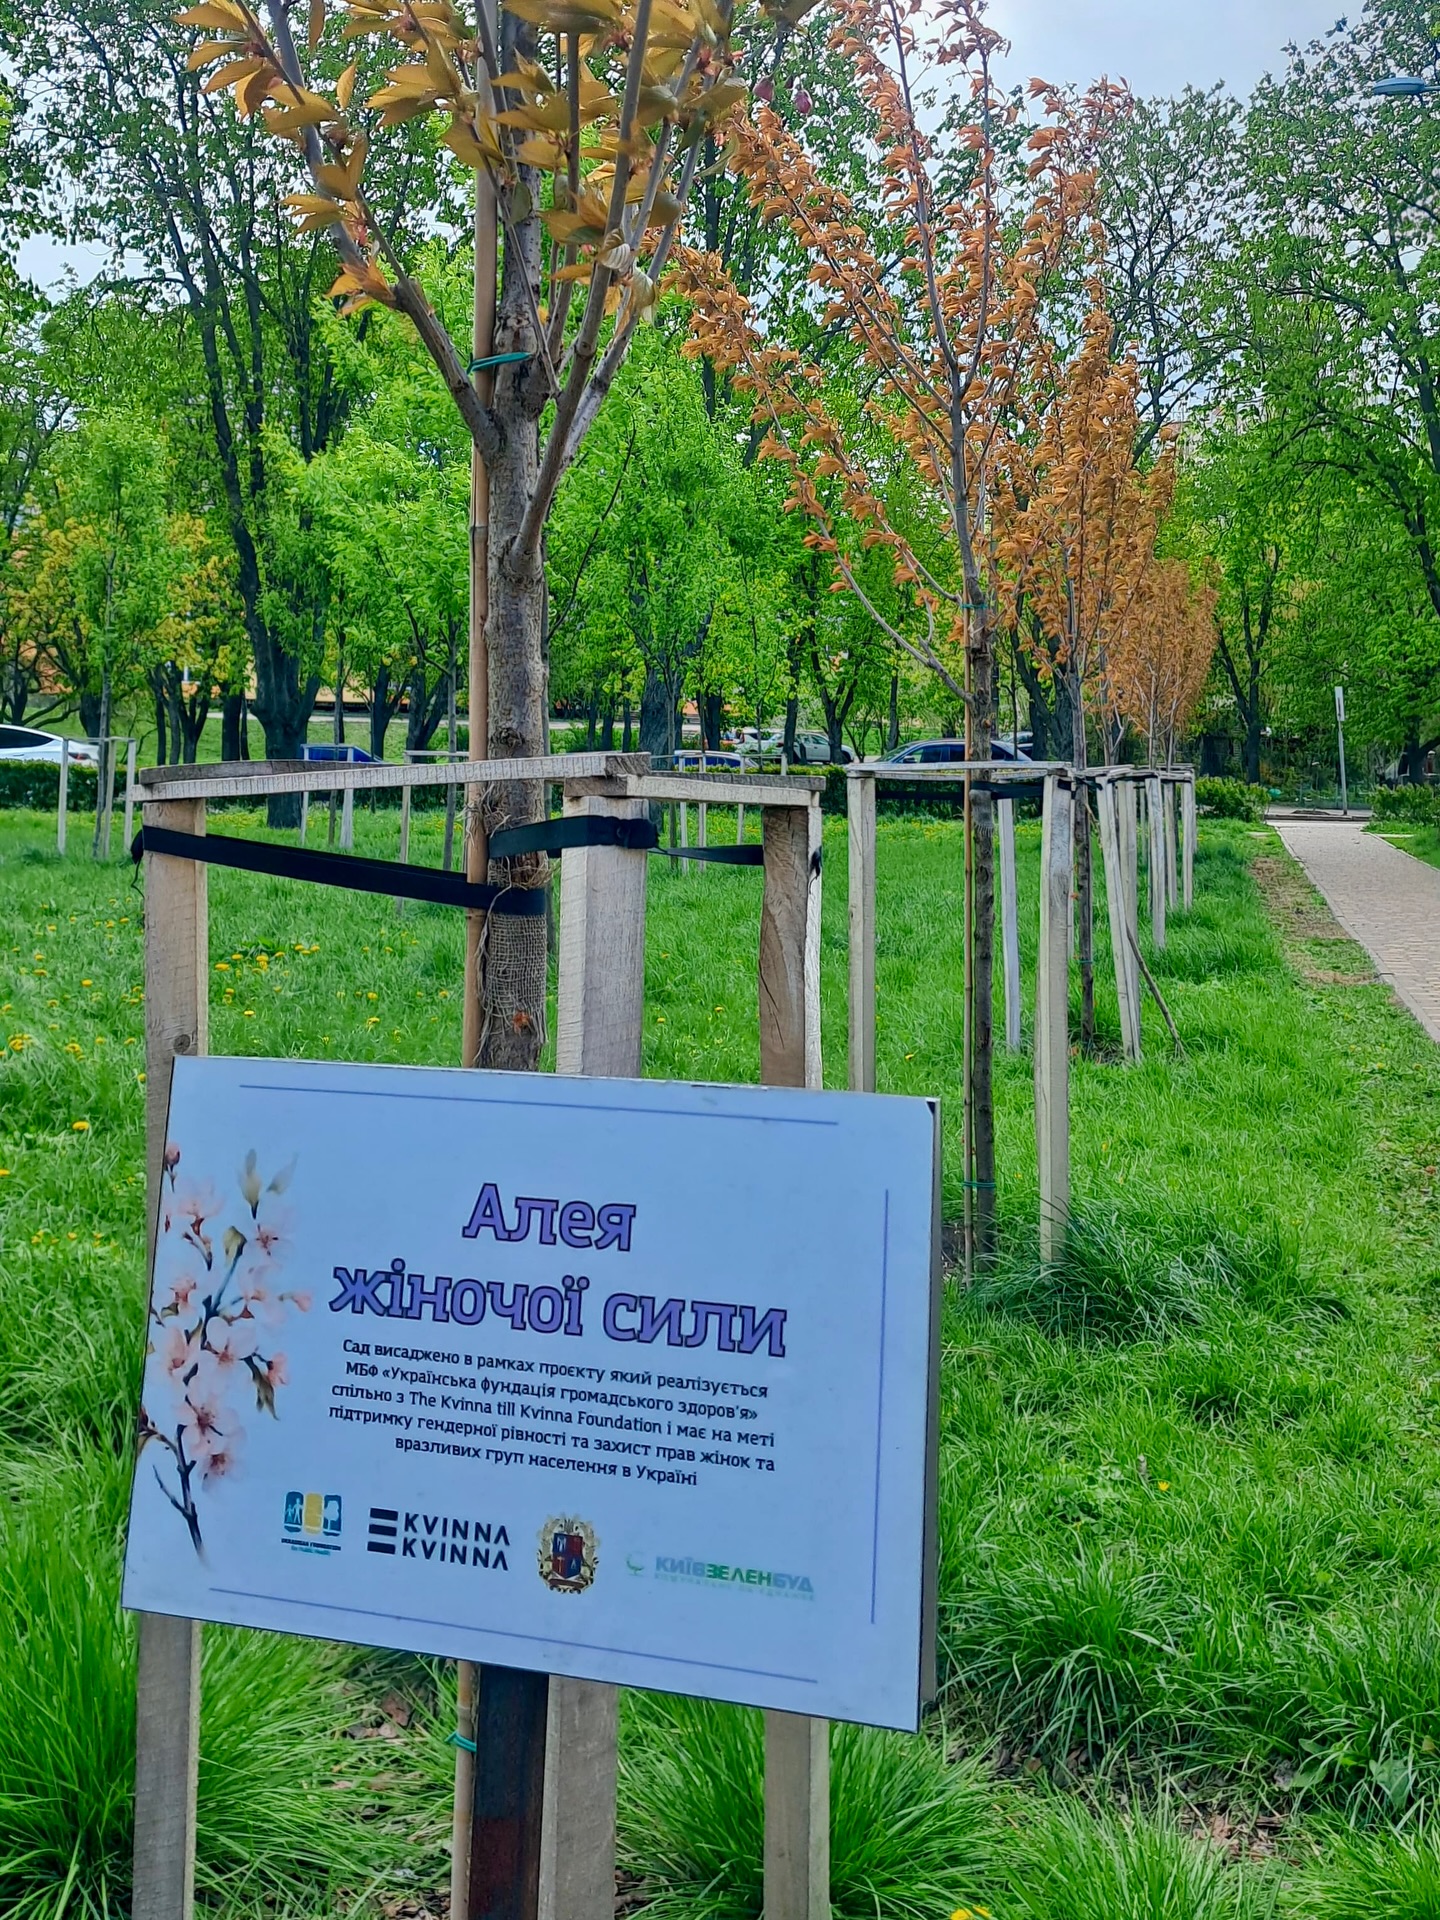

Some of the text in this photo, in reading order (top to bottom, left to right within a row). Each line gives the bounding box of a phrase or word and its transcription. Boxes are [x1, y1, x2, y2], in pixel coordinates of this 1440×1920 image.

[462, 1182, 637, 1252] Алея
[329, 1257, 788, 1358] жіночої сили
[343, 1339, 768, 1398] Сад висаджено в рамках проєкту який реалізується
[346, 1361, 378, 1377] МБФ
[382, 1366, 477, 1389] «Українська
[481, 1376, 556, 1399] фундація
[560, 1388, 674, 1411] громадського
[329, 1404, 775, 1471] підтримку гендерної рівності та захист прав жінок та
[332, 1384, 774, 1447] спільно з The Kvinna till Kvinna Foundation і має на меті
[395, 1438, 697, 1485] вразливих груп населення в Україні
[402, 1538, 509, 1572] KVINNA
[403, 1511, 511, 1546] KVINNA
